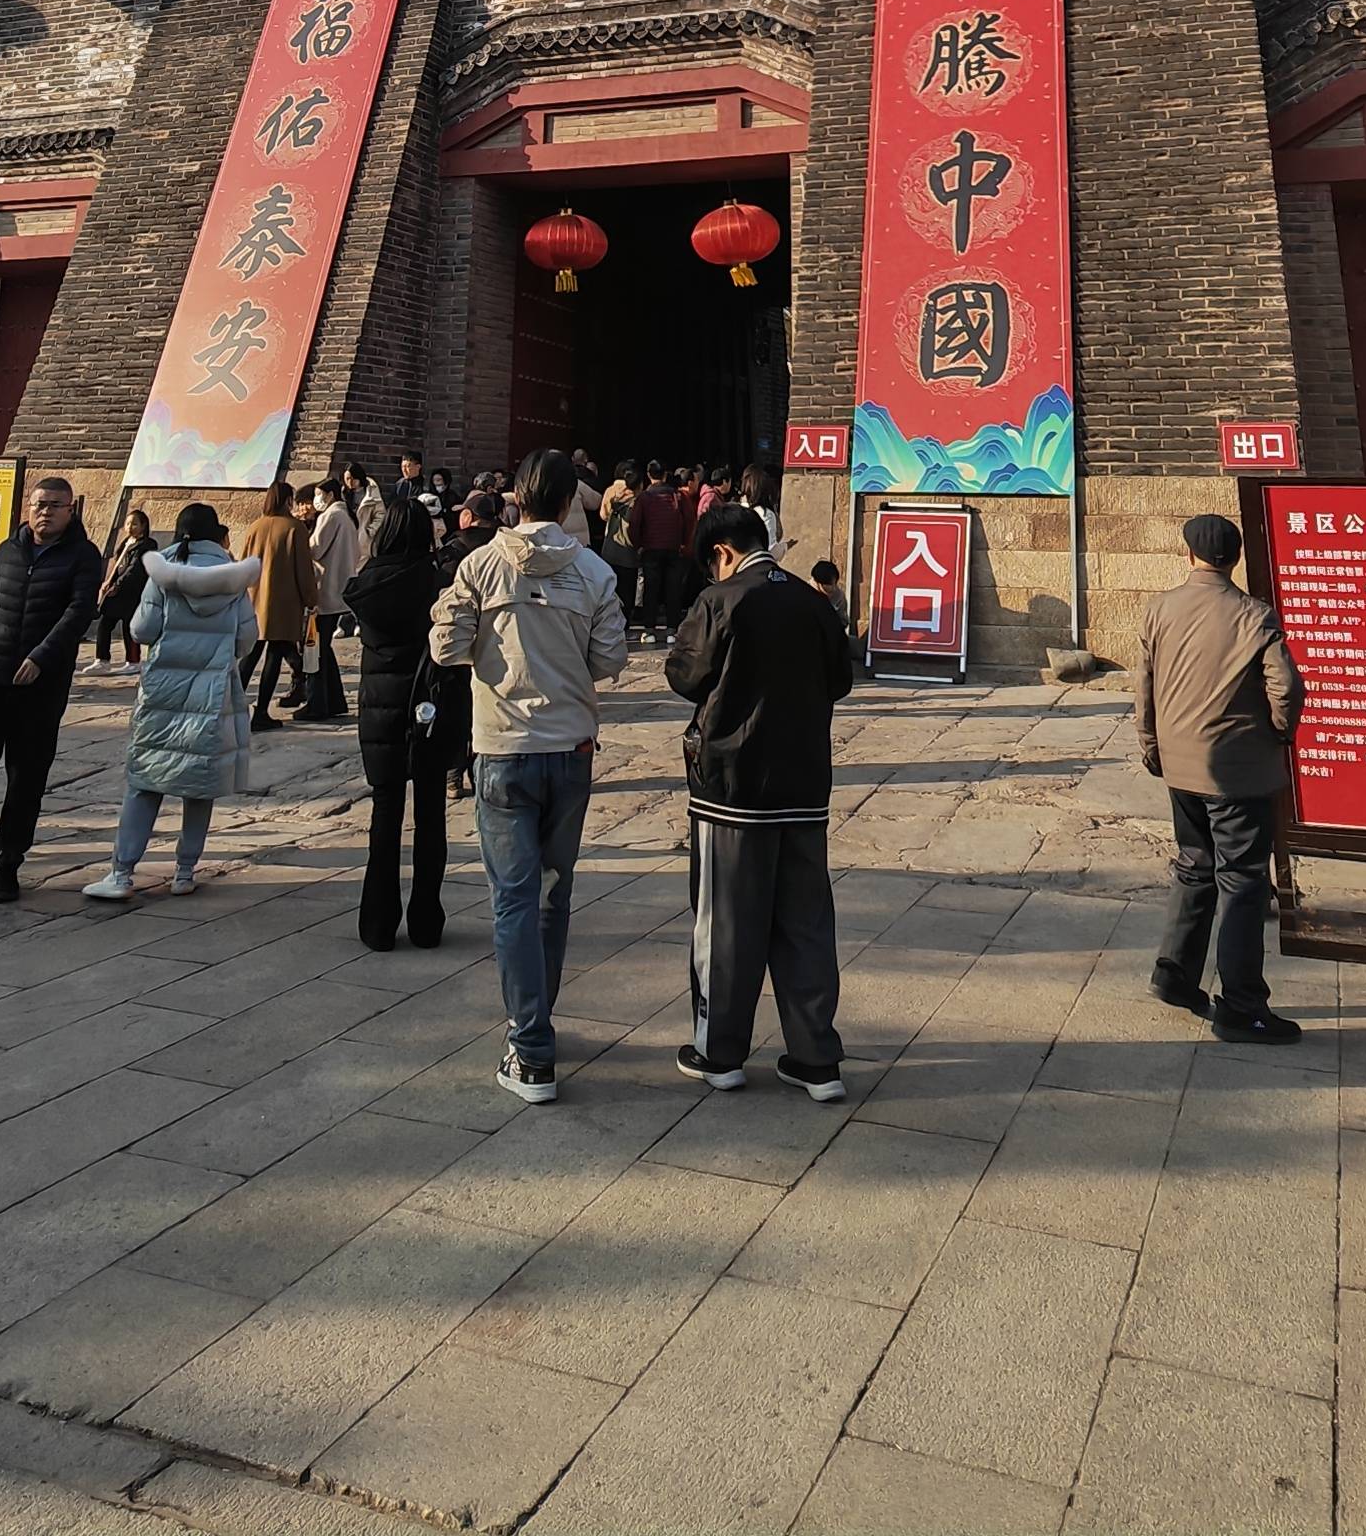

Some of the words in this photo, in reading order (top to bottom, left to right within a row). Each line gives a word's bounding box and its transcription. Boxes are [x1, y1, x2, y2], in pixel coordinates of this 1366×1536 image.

[794, 434, 837, 459] 入口
[1232, 431, 1285, 460] 出口
[891, 531, 948, 632] 入口
